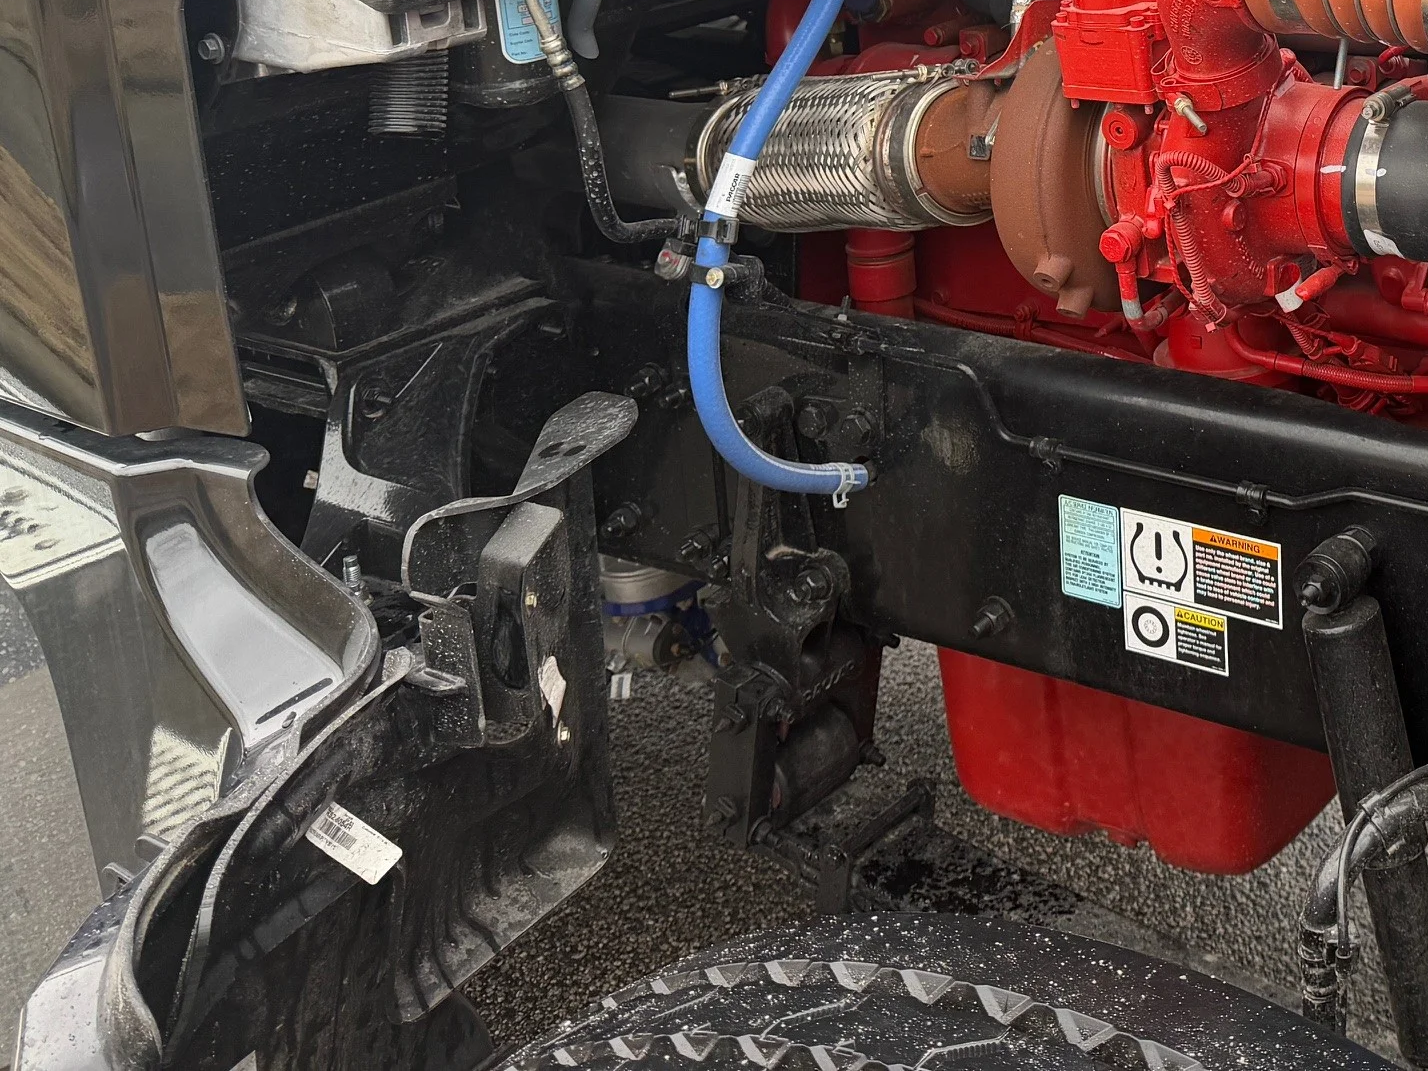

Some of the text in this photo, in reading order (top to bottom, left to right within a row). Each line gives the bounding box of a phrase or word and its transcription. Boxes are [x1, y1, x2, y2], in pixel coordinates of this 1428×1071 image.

[726, 172, 740, 202] PACCAR
[1217, 536, 1259, 552] WARNING
[1183, 611, 1223, 628] CAUTION
